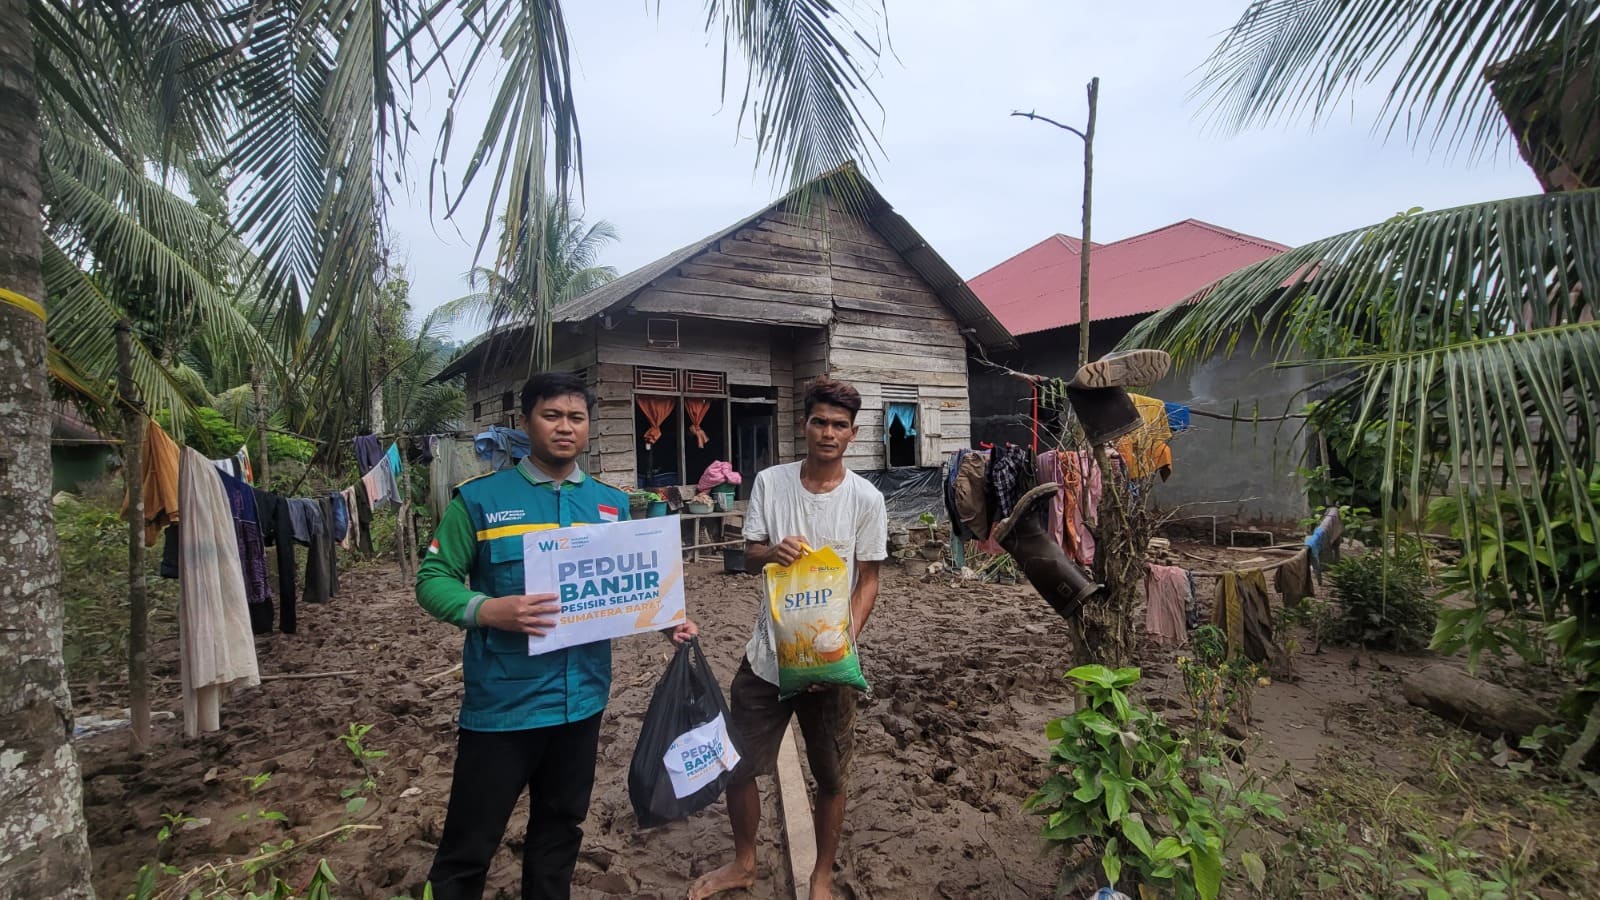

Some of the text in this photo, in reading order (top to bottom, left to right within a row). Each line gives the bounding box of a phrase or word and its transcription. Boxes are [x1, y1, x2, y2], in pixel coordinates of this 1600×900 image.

[558, 550, 658, 582] PEDULI
[560, 571, 660, 603] BANJIR
[784, 588, 833, 609] SPHP
[559, 600, 662, 625] SUMATERA BARAT
[560, 591, 660, 614] PESISIR SELATAN
